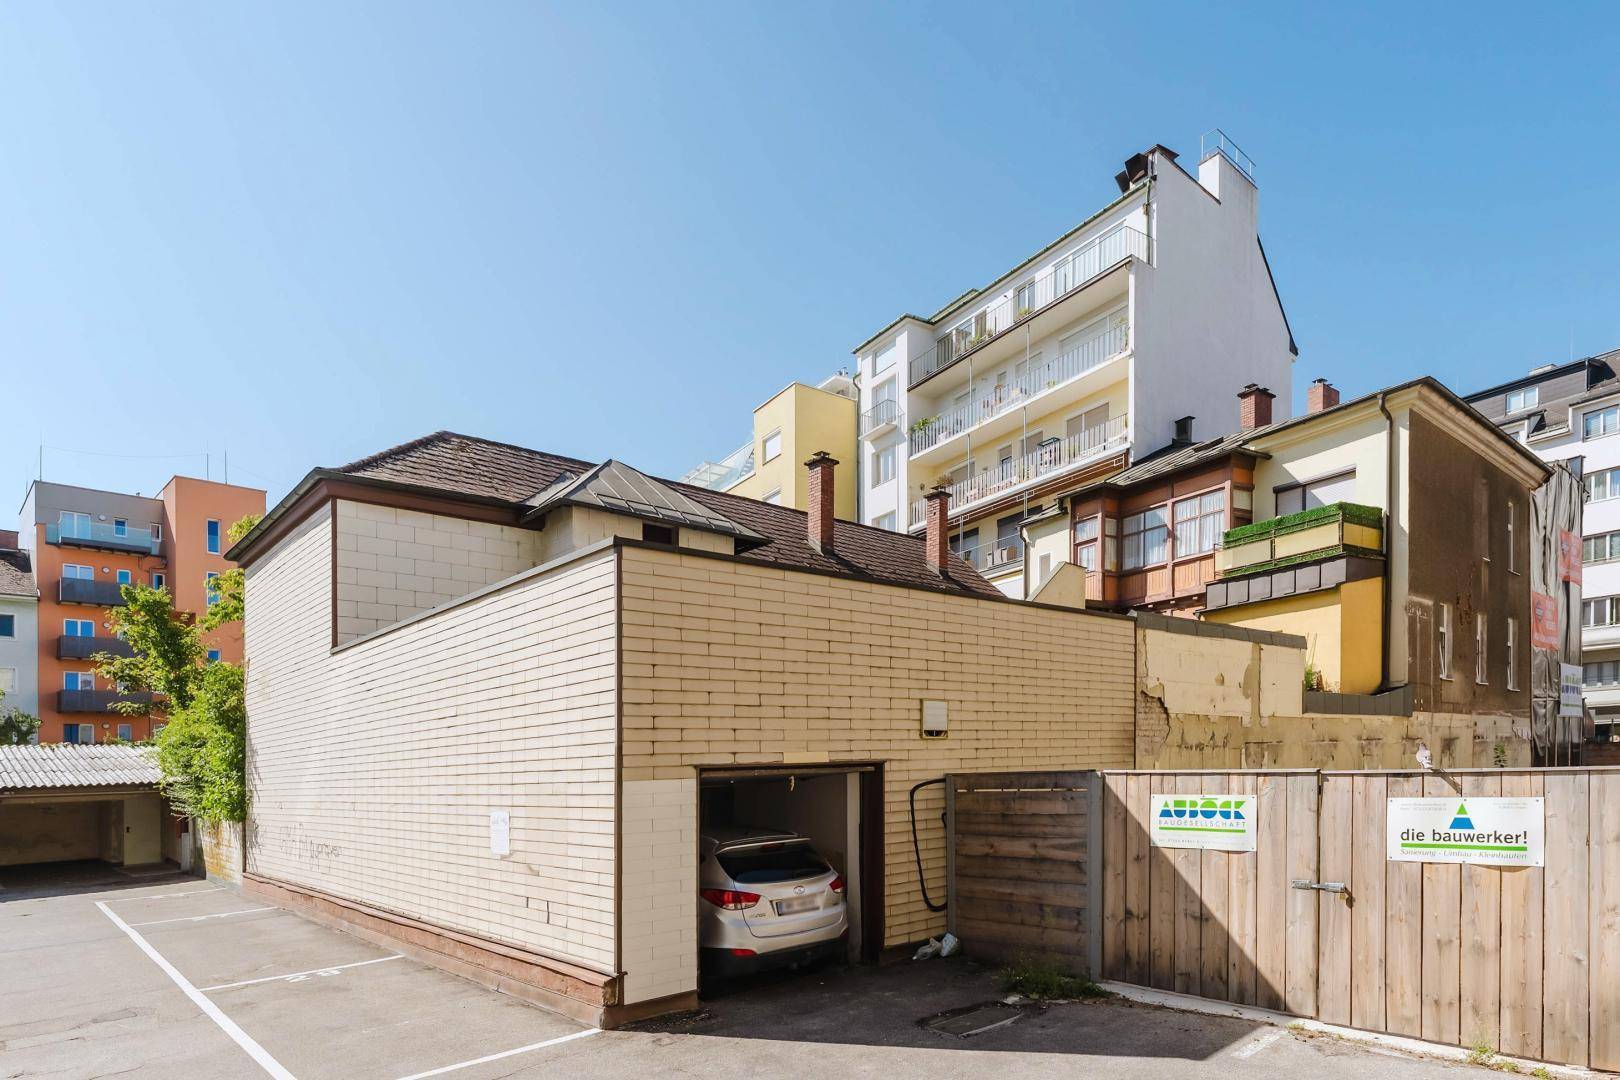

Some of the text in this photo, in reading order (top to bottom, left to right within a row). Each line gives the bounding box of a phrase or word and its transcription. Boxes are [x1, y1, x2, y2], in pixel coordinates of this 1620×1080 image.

[1159, 798, 1245, 819] AUBÖCK
[1159, 819, 1246, 828] BAUGESELLSCHAFT
[1400, 828, 1527, 844] die bauwerker!
[1400, 849, 1436, 857] Sanierung
